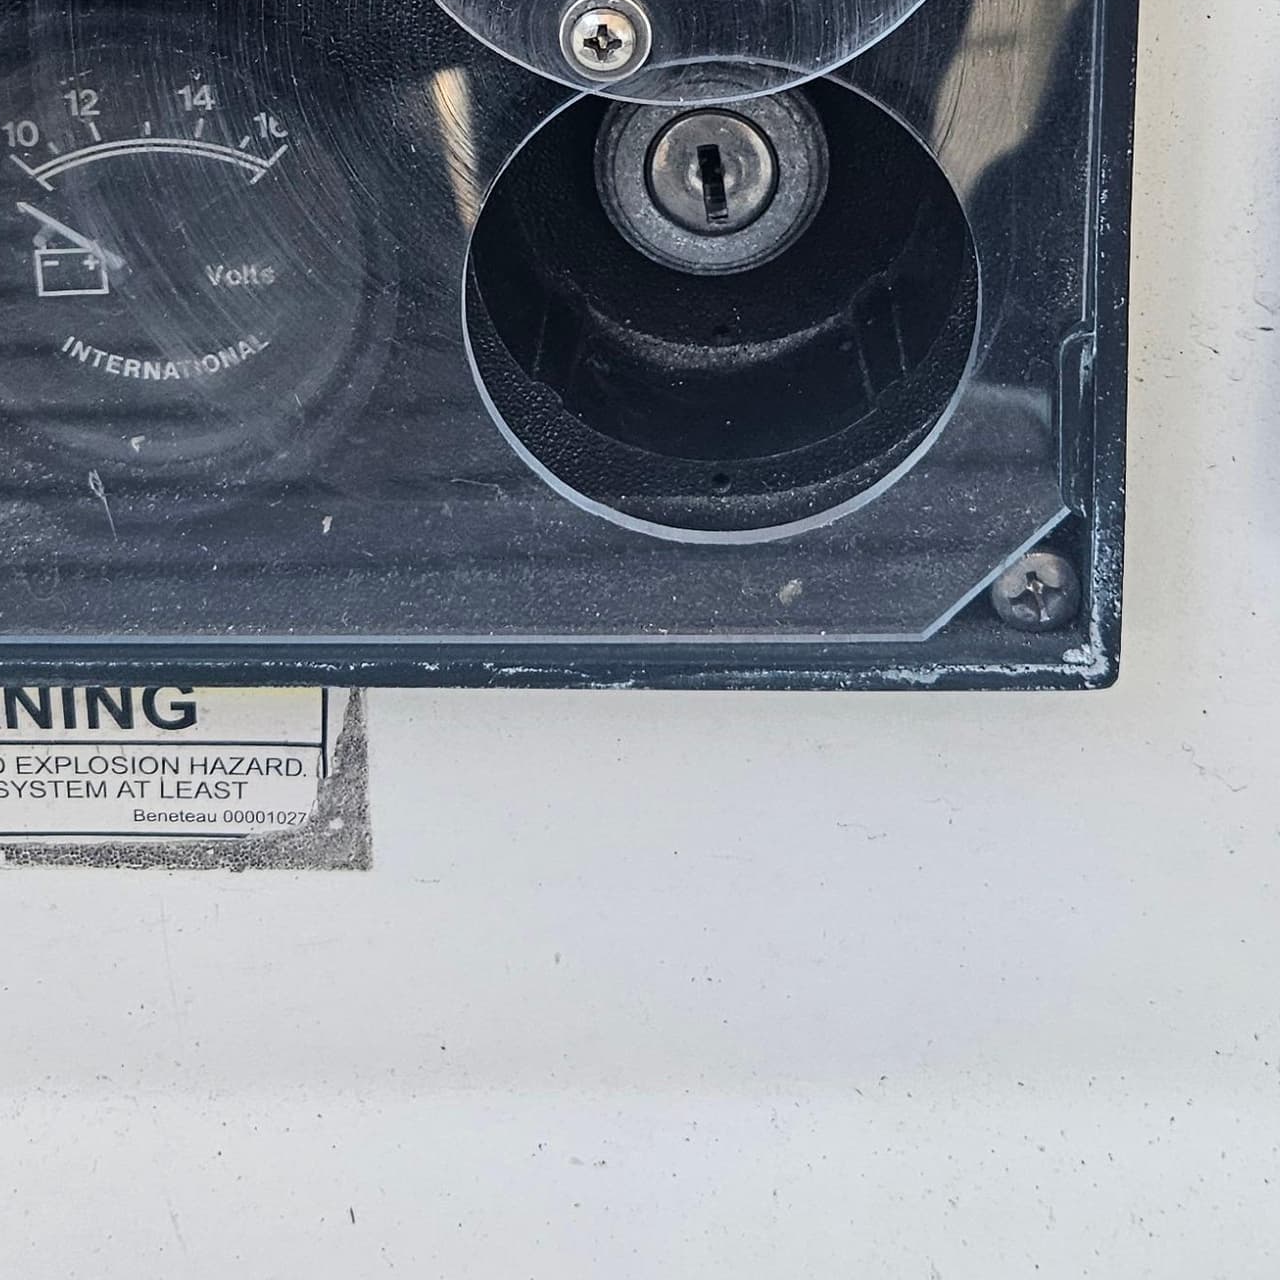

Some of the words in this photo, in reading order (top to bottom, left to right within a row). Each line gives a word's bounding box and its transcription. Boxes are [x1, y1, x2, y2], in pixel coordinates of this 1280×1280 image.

[64, 88, 101, 117] 12
[178, 84, 216, 112] 14
[2, 120, 39, 148] 10
[206, 264, 275, 287] Volts
[61, 334, 269, 381] INTERNATIONAL
[19, 756, 180, 775] EXPLOSION
[190, 757, 308, 777] HAZARD.
[116, 780, 151, 799] AT
[160, 781, 249, 800] LEAST
[133, 808, 217, 823] Beneteau
[222, 809, 307, 825] 00001027
